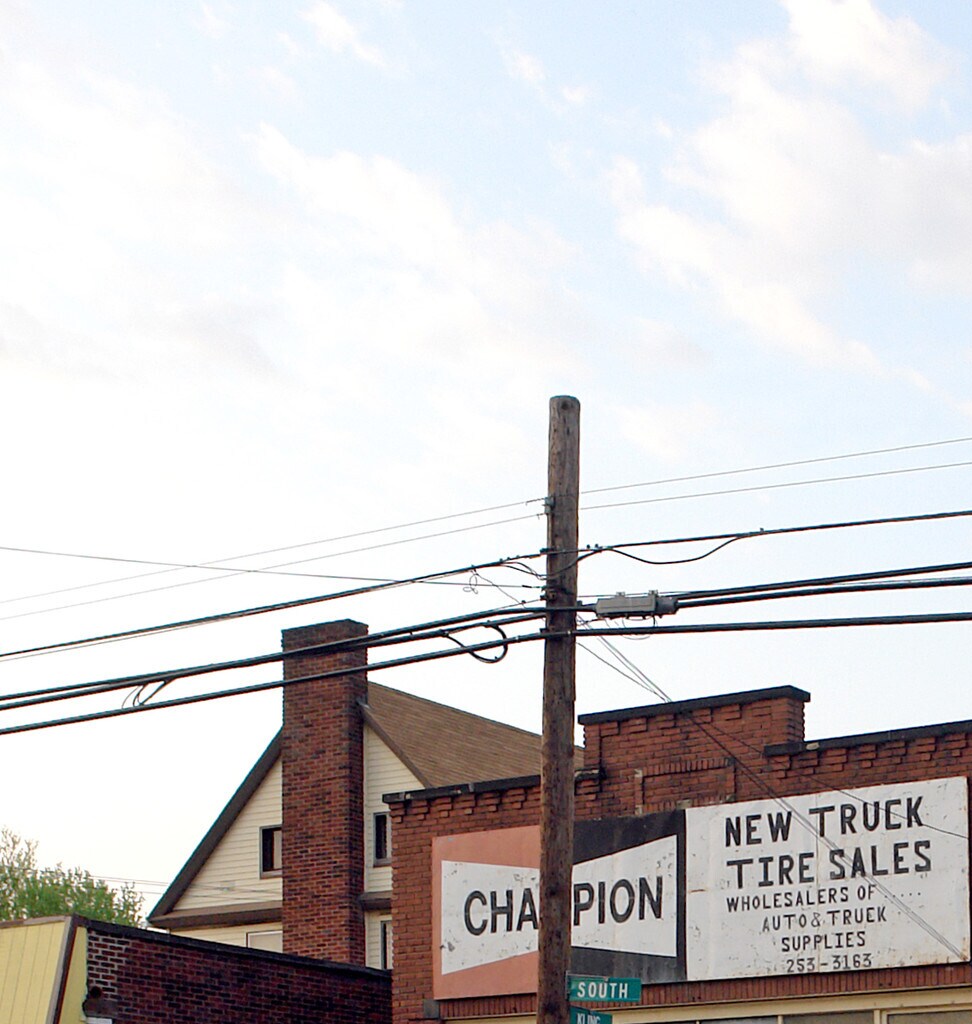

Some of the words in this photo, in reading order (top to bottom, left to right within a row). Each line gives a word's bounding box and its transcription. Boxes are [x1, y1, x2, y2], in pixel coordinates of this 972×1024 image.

[725, 811, 792, 847] NEW
[809, 796, 923, 838] TRUCK
[726, 852, 815, 889] TIRE
[829, 840, 931, 880] SALES
[464, 876, 663, 936] CHAPION
[726, 886, 849, 912] WHOLESALERS
[762, 913, 807, 932] AUTO
[827, 906, 887, 926] TRUCK
[781, 931, 866, 952] SUPPLIES
[786, 953, 872, 973] 253-3163
[577, 982, 628, 998] SOUTH
